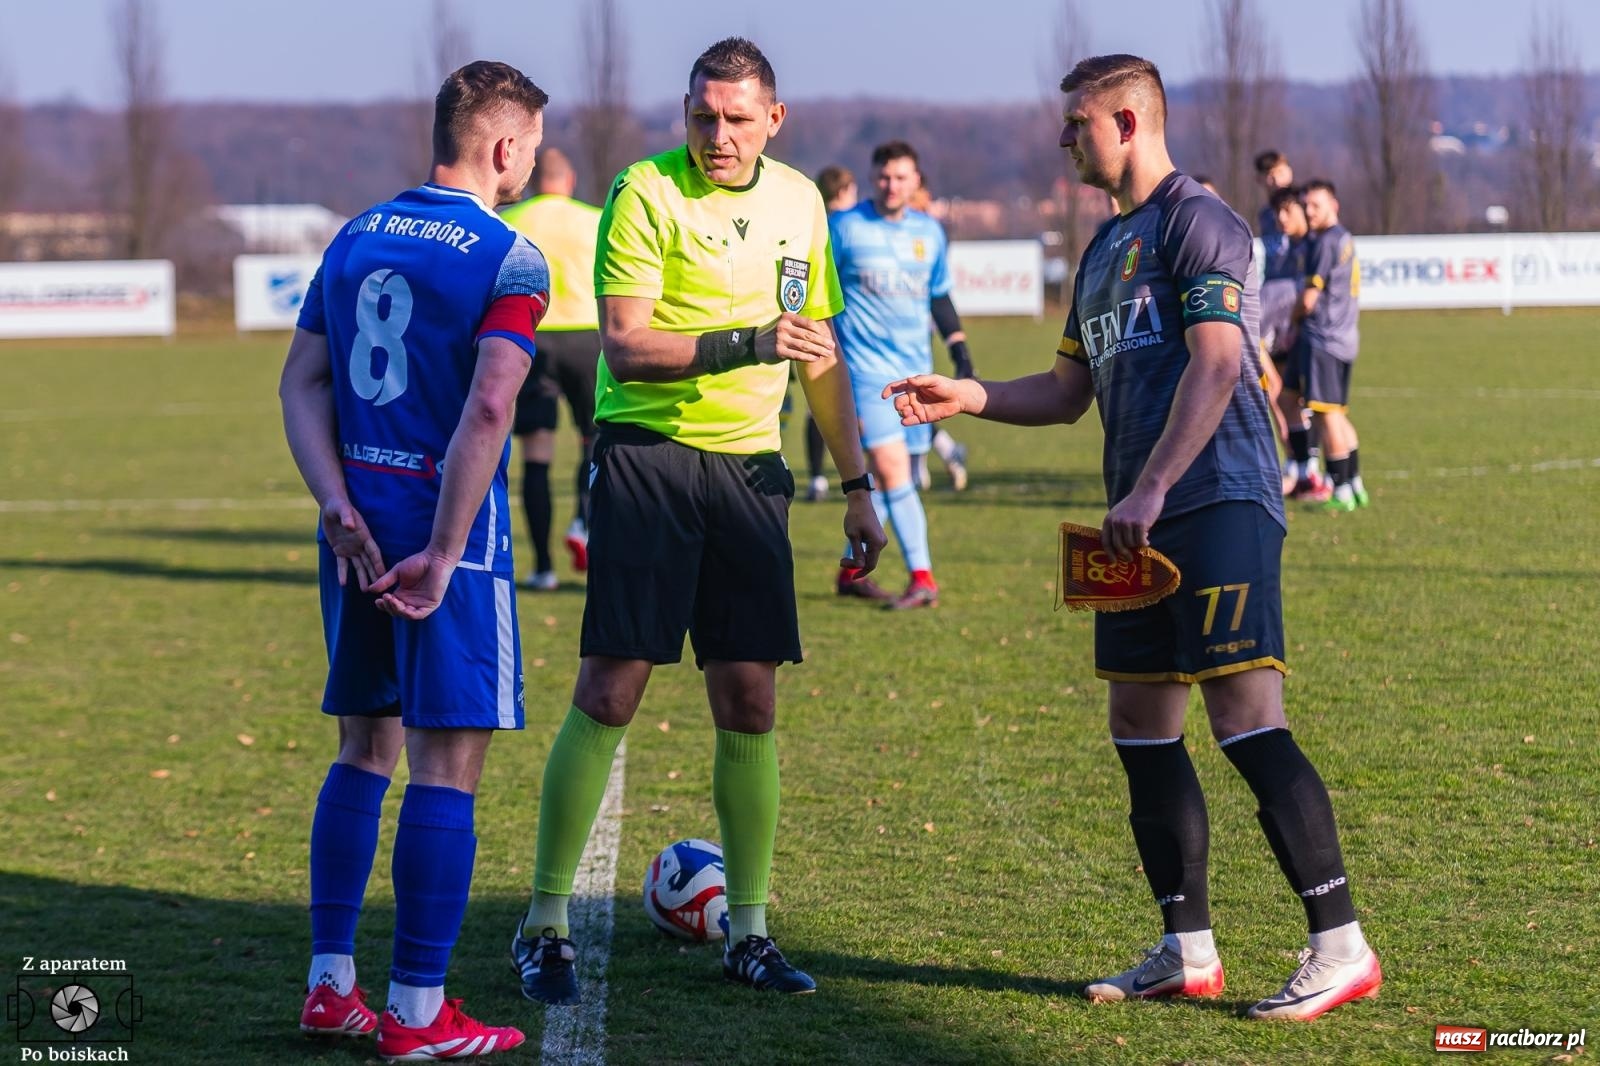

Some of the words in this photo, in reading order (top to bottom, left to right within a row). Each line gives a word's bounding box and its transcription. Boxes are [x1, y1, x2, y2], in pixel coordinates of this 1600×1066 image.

[384, 214, 481, 255] RACIBÓRZ
[349, 267, 414, 407] 8
[1195, 582, 1250, 636] 77
